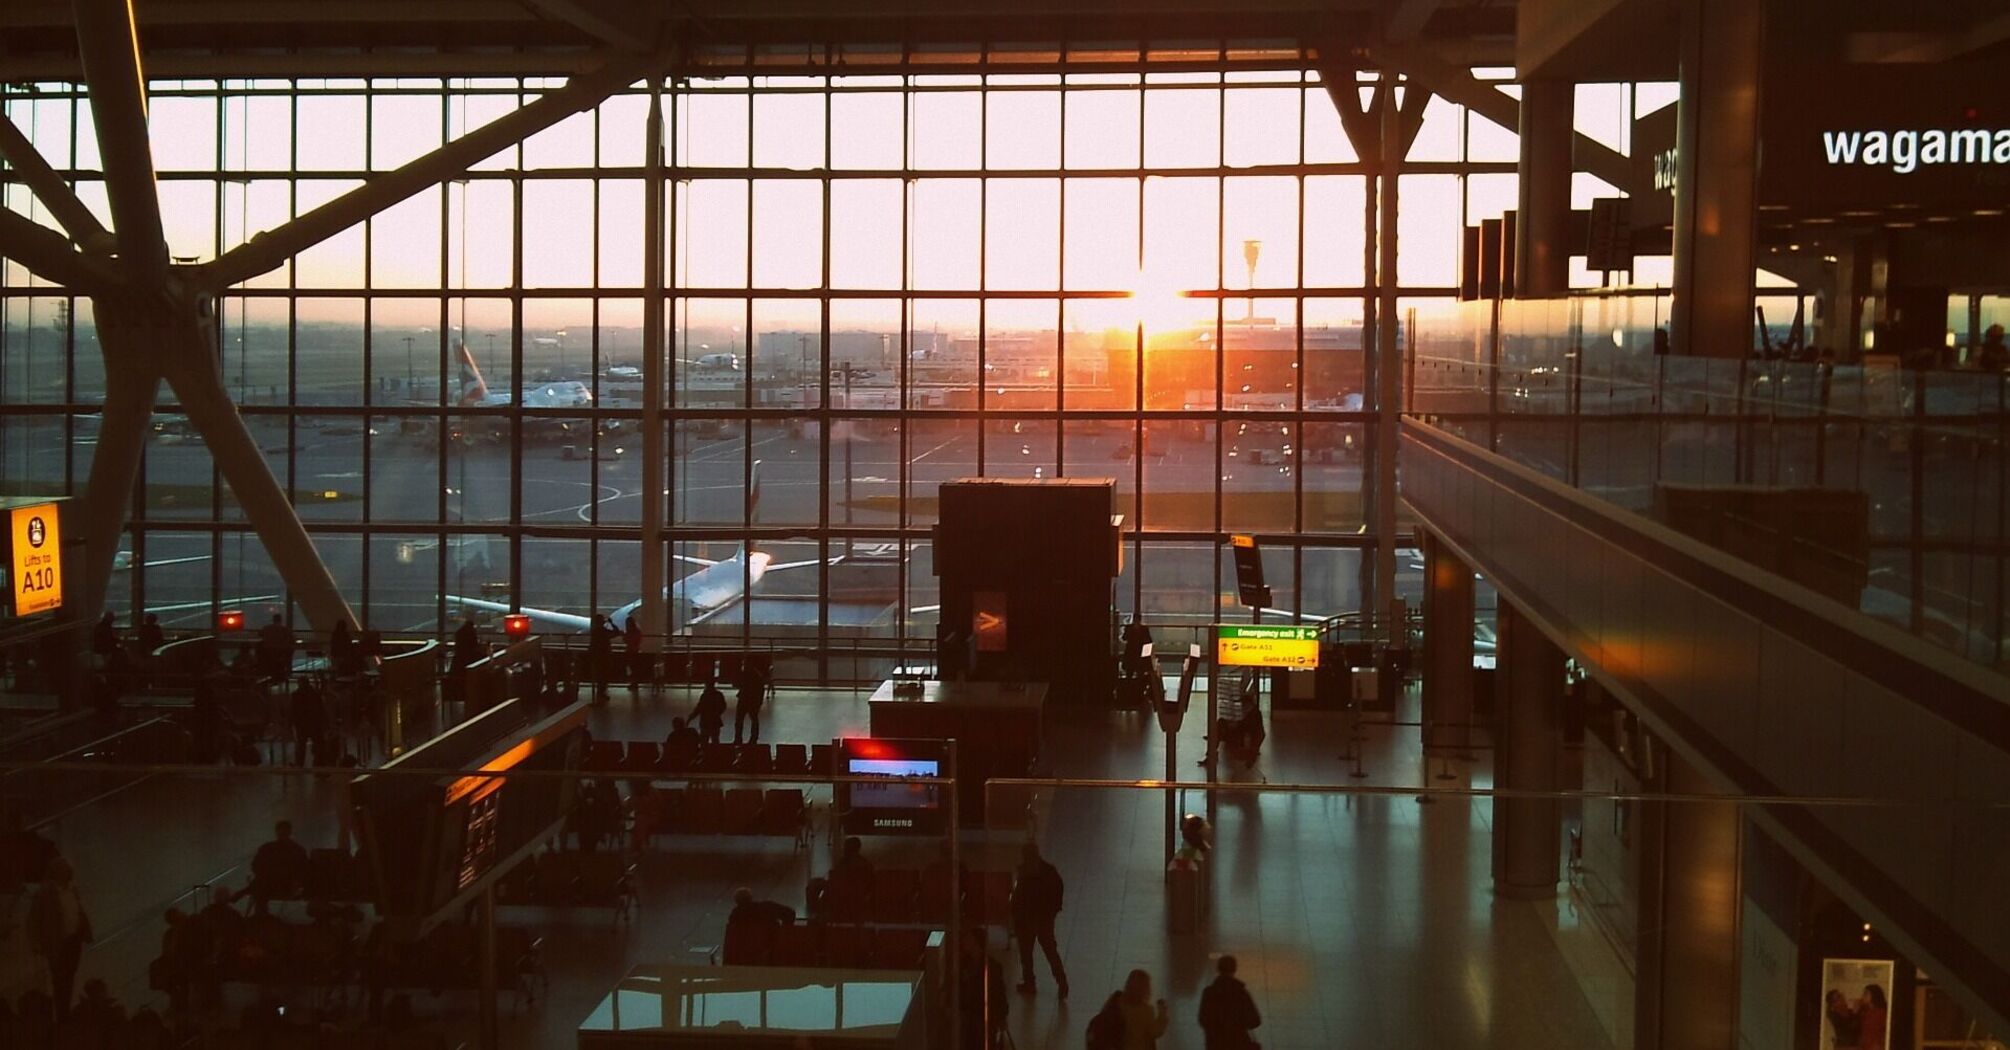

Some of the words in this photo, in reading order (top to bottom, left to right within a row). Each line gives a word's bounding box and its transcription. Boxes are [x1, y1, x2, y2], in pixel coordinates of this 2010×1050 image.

[25, 555, 41, 567] Lifts
[43, 554, 51, 564] to
[22, 567, 54, 593] A10
[1238, 628, 1279, 639] Emergency
[1280, 630, 1295, 638] exit
[874, 819, 912, 827] SAMSUNG
